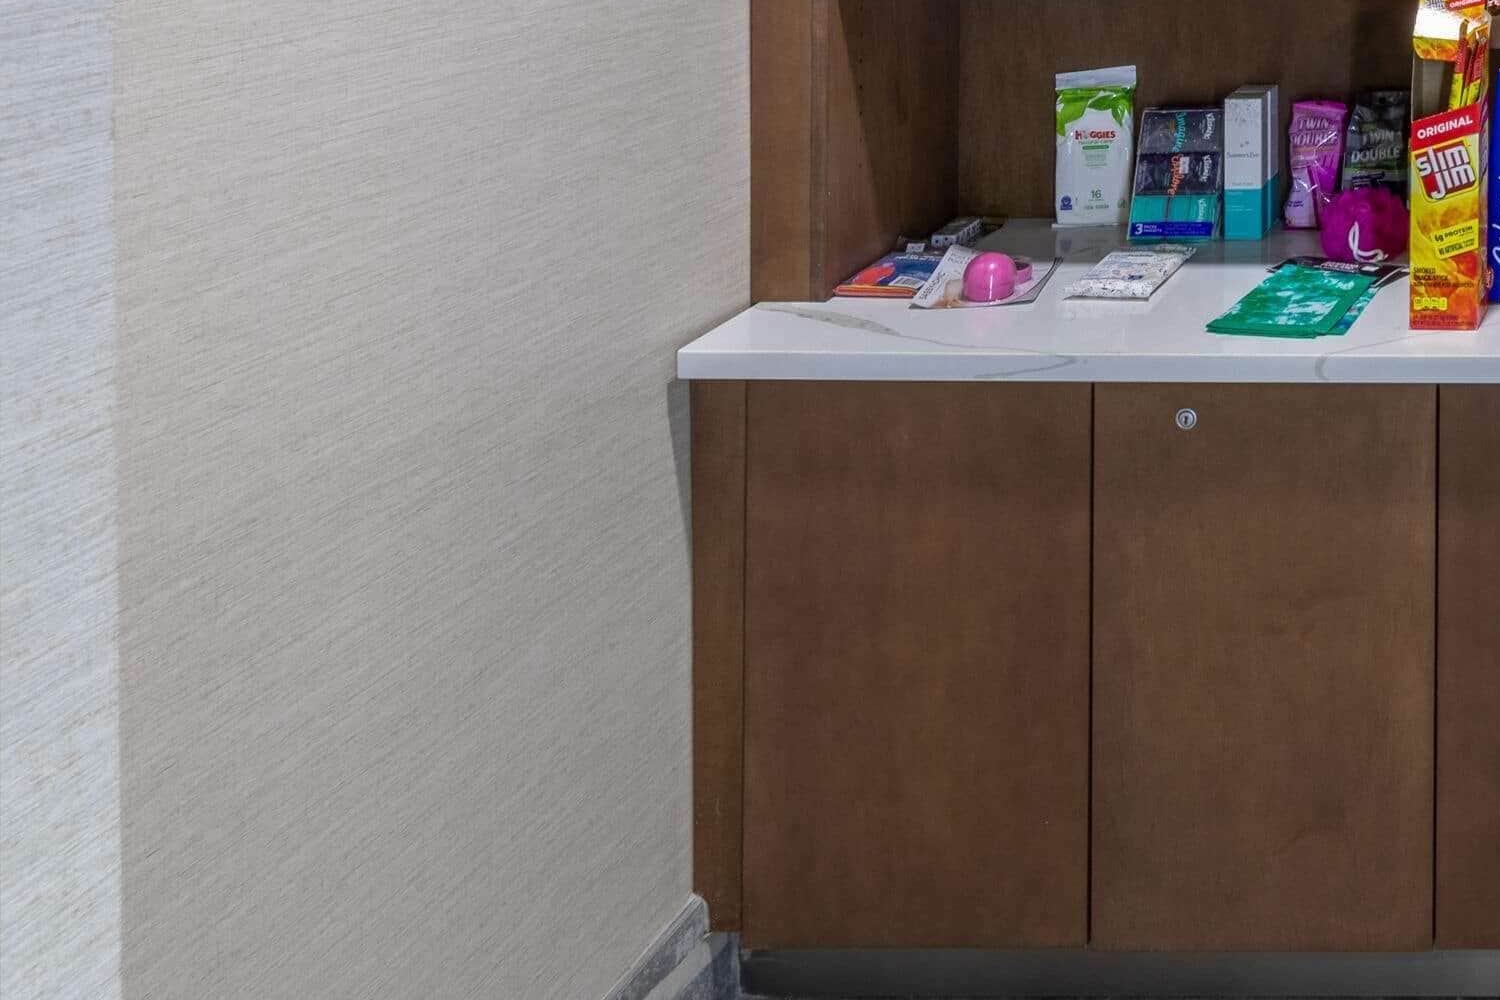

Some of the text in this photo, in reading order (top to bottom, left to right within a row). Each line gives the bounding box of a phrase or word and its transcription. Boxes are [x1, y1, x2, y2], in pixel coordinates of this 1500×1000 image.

[1416, 115, 1474, 140] ORIGINAL
[1074, 130, 1117, 141] HGGIES
[1350, 145, 1401, 163] DOUBLE
[1134, 223, 1144, 235] 3
